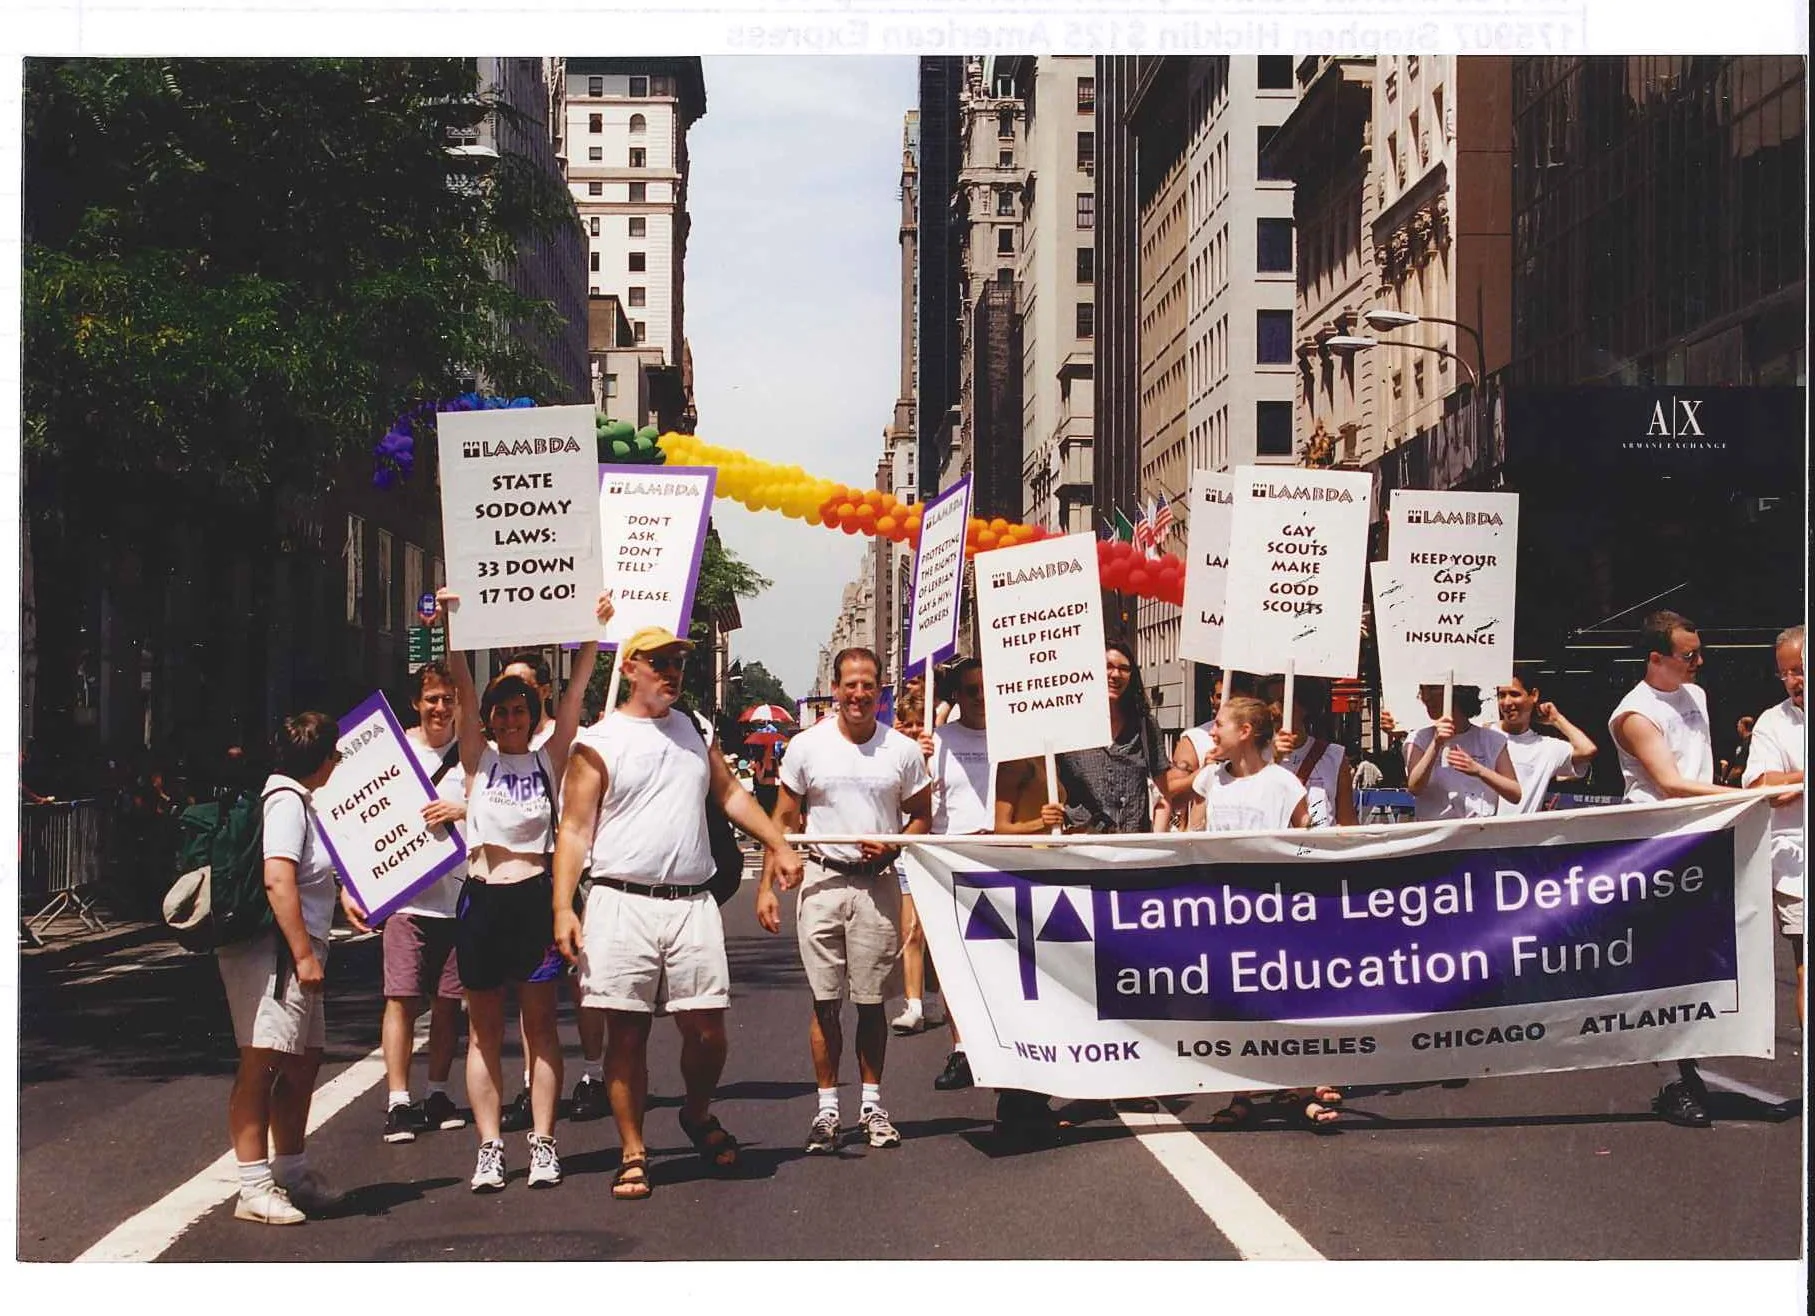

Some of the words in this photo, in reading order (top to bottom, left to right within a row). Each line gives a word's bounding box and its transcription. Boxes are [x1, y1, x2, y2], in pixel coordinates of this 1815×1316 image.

[483, 436, 580, 457] LAMBDA
[492, 472, 553, 491] STATE
[624, 482, 699, 496] LAMBDA
[1218, 490, 1233, 504] LA
[1268, 484, 1353, 504] LAMBDA
[475, 499, 572, 519] SODOMY
[931, 498, 963, 526] LAMBDA
[1423, 511, 1503, 526] LAMBDA
[495, 528, 556, 546] LAWS:
[1282, 525, 1316, 537] GAY
[921, 533, 960, 564] PROTECTING
[1267, 542, 1327, 556] SCOUTS
[1410, 552, 1447, 566] KEEP
[1451, 554, 1497, 566] YOUR
[478, 561, 499, 577] 33
[506, 556, 574, 575] DOWN
[921, 567, 933, 580] THE
[935, 552, 957, 573] RIGHTS
[1006, 558, 1083, 586] LAMBDA
[1271, 560, 1320, 575] MAKE
[918, 586, 927, 599] OF
[928, 570, 954, 594] LESBIAN
[1434, 571, 1471, 584] CAPS
[479, 588, 500, 604] 17
[505, 586, 535, 602] TO
[540, 583, 576, 600] GO!
[1269, 582, 1318, 596] GOOD
[1437, 591, 1466, 603] OFF
[918, 602, 931, 616] GAY
[991, 615, 1017, 630] GET
[1020, 602, 1088, 625] ENGAGED!
[1263, 600, 1323, 614] SCOUTS
[918, 606, 949, 632] WORKERS
[1438, 614, 1463, 625] MY
[1002, 632, 1037, 648] HELP
[1040, 623, 1081, 643] FIGHT
[1406, 631, 1495, 645] INSURANCE
[1029, 650, 1057, 664] FOR
[996, 680, 1023, 695] THE
[1026, 670, 1094, 691] FREEDOM
[1008, 700, 1027, 714] TO
[1032, 692, 1084, 711] MARRY
[336, 723, 385, 765] MBDA
[486, 763, 546, 801] LAMBD
[331, 765, 401, 821] FIGHTING
[359, 797, 391, 824] FOR
[374, 823, 408, 853] OUR
[371, 831, 430, 880] RIGHTS!
[1110, 882, 1317, 930] Lambda
[1341, 872, 1474, 927] Legal
[1495, 864, 1704, 913] Defense
[1116, 954, 1208, 995] and
[1232, 943, 1489, 994] Education
[1512, 928, 1633, 977] Fund
[1015, 1041, 1057, 1062] NEW
[1068, 1041, 1140, 1062] YORK
[1177, 1039, 1232, 1057] LOS
[1240, 1036, 1377, 1056] ANGELES
[1412, 1023, 1546, 1050] CHICAGO
[1580, 1002, 1716, 1035] ATLANTA
